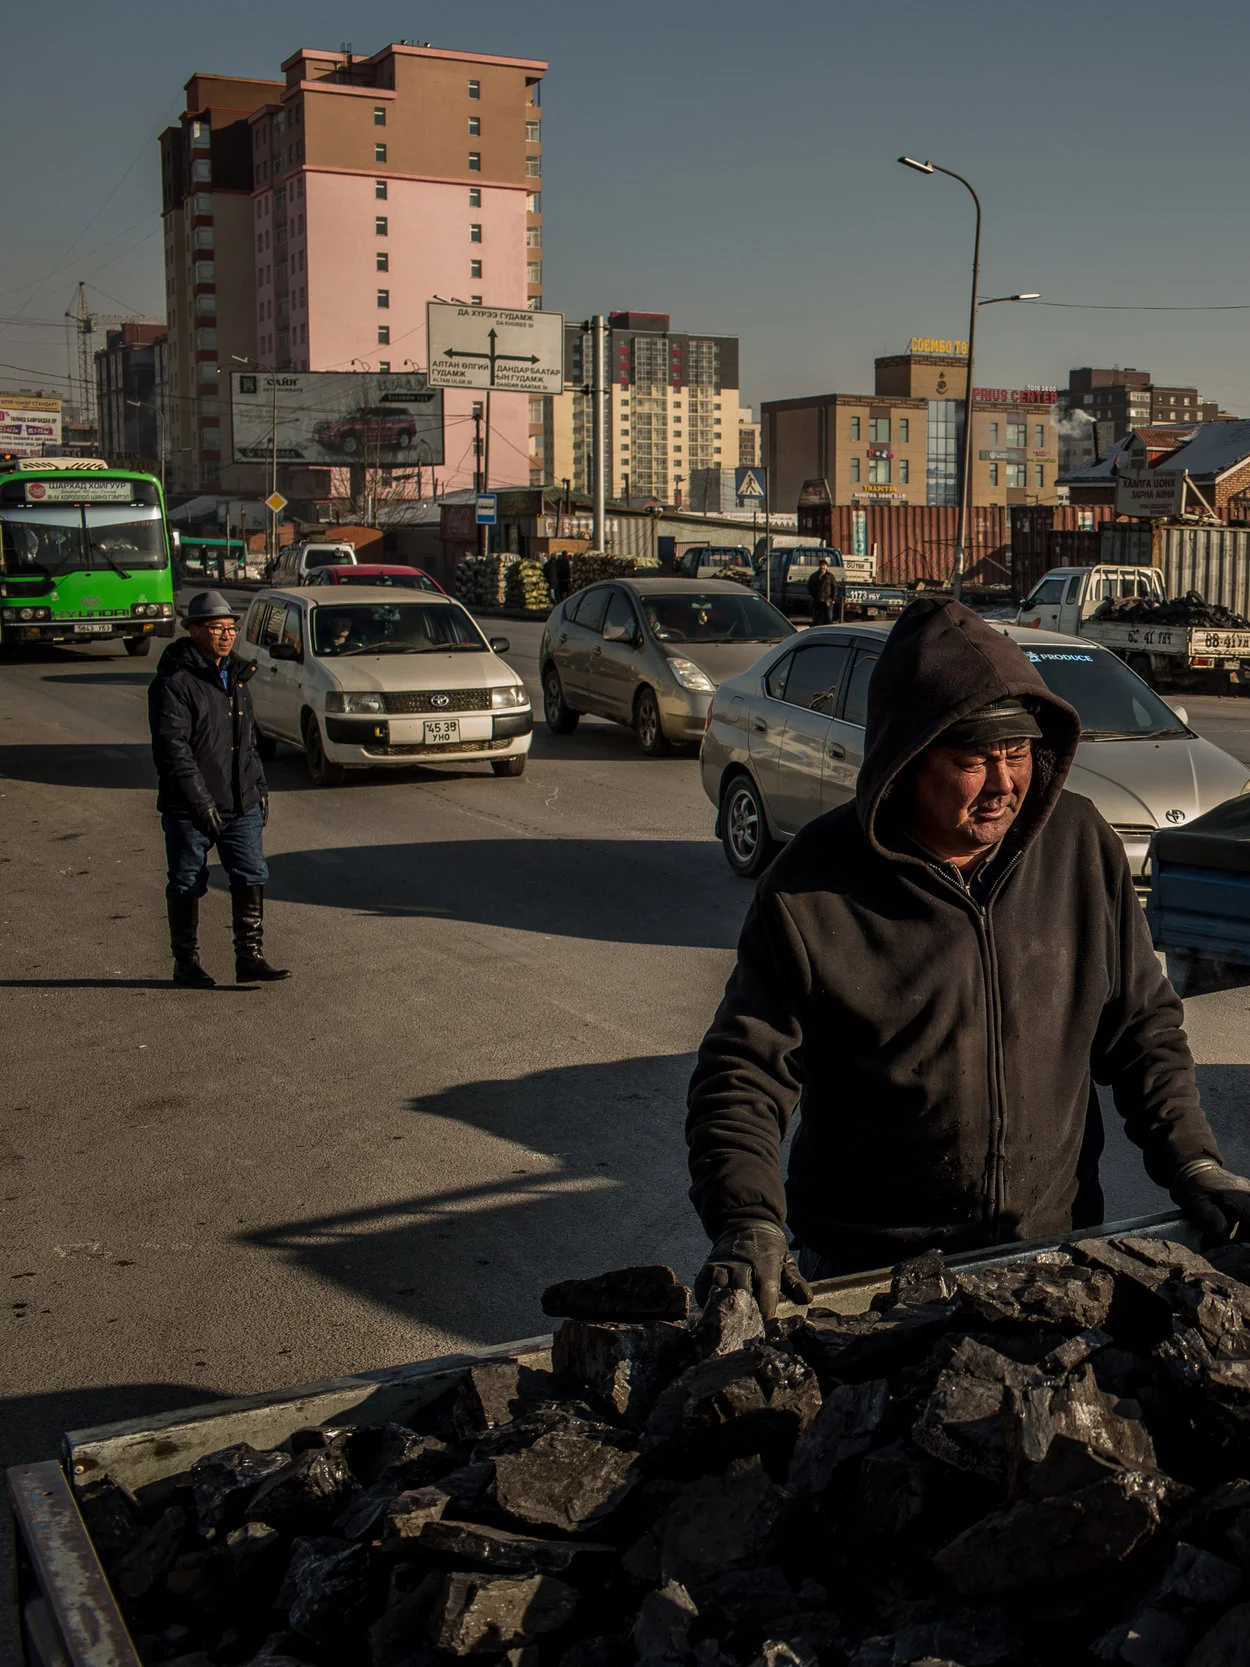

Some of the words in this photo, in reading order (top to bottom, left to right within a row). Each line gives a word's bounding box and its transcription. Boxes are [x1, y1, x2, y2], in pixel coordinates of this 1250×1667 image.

[457, 308, 469, 316] ДА
[500, 313, 534, 321] ГУДАМЖ
[432, 360, 460, 369] АЛТАН
[432, 369, 466, 377] ГУДАМЖ
[511, 375, 544, 384] ГУДАМЖ
[972, 388, 1007, 402] PRIUS
[1011, 389, 1058, 404] CENTER
[49, 482, 87, 490] ШАРХАД
[51, 608, 129, 618] HYUNDAI
[1040, 653, 1094, 662] PRODUCE
